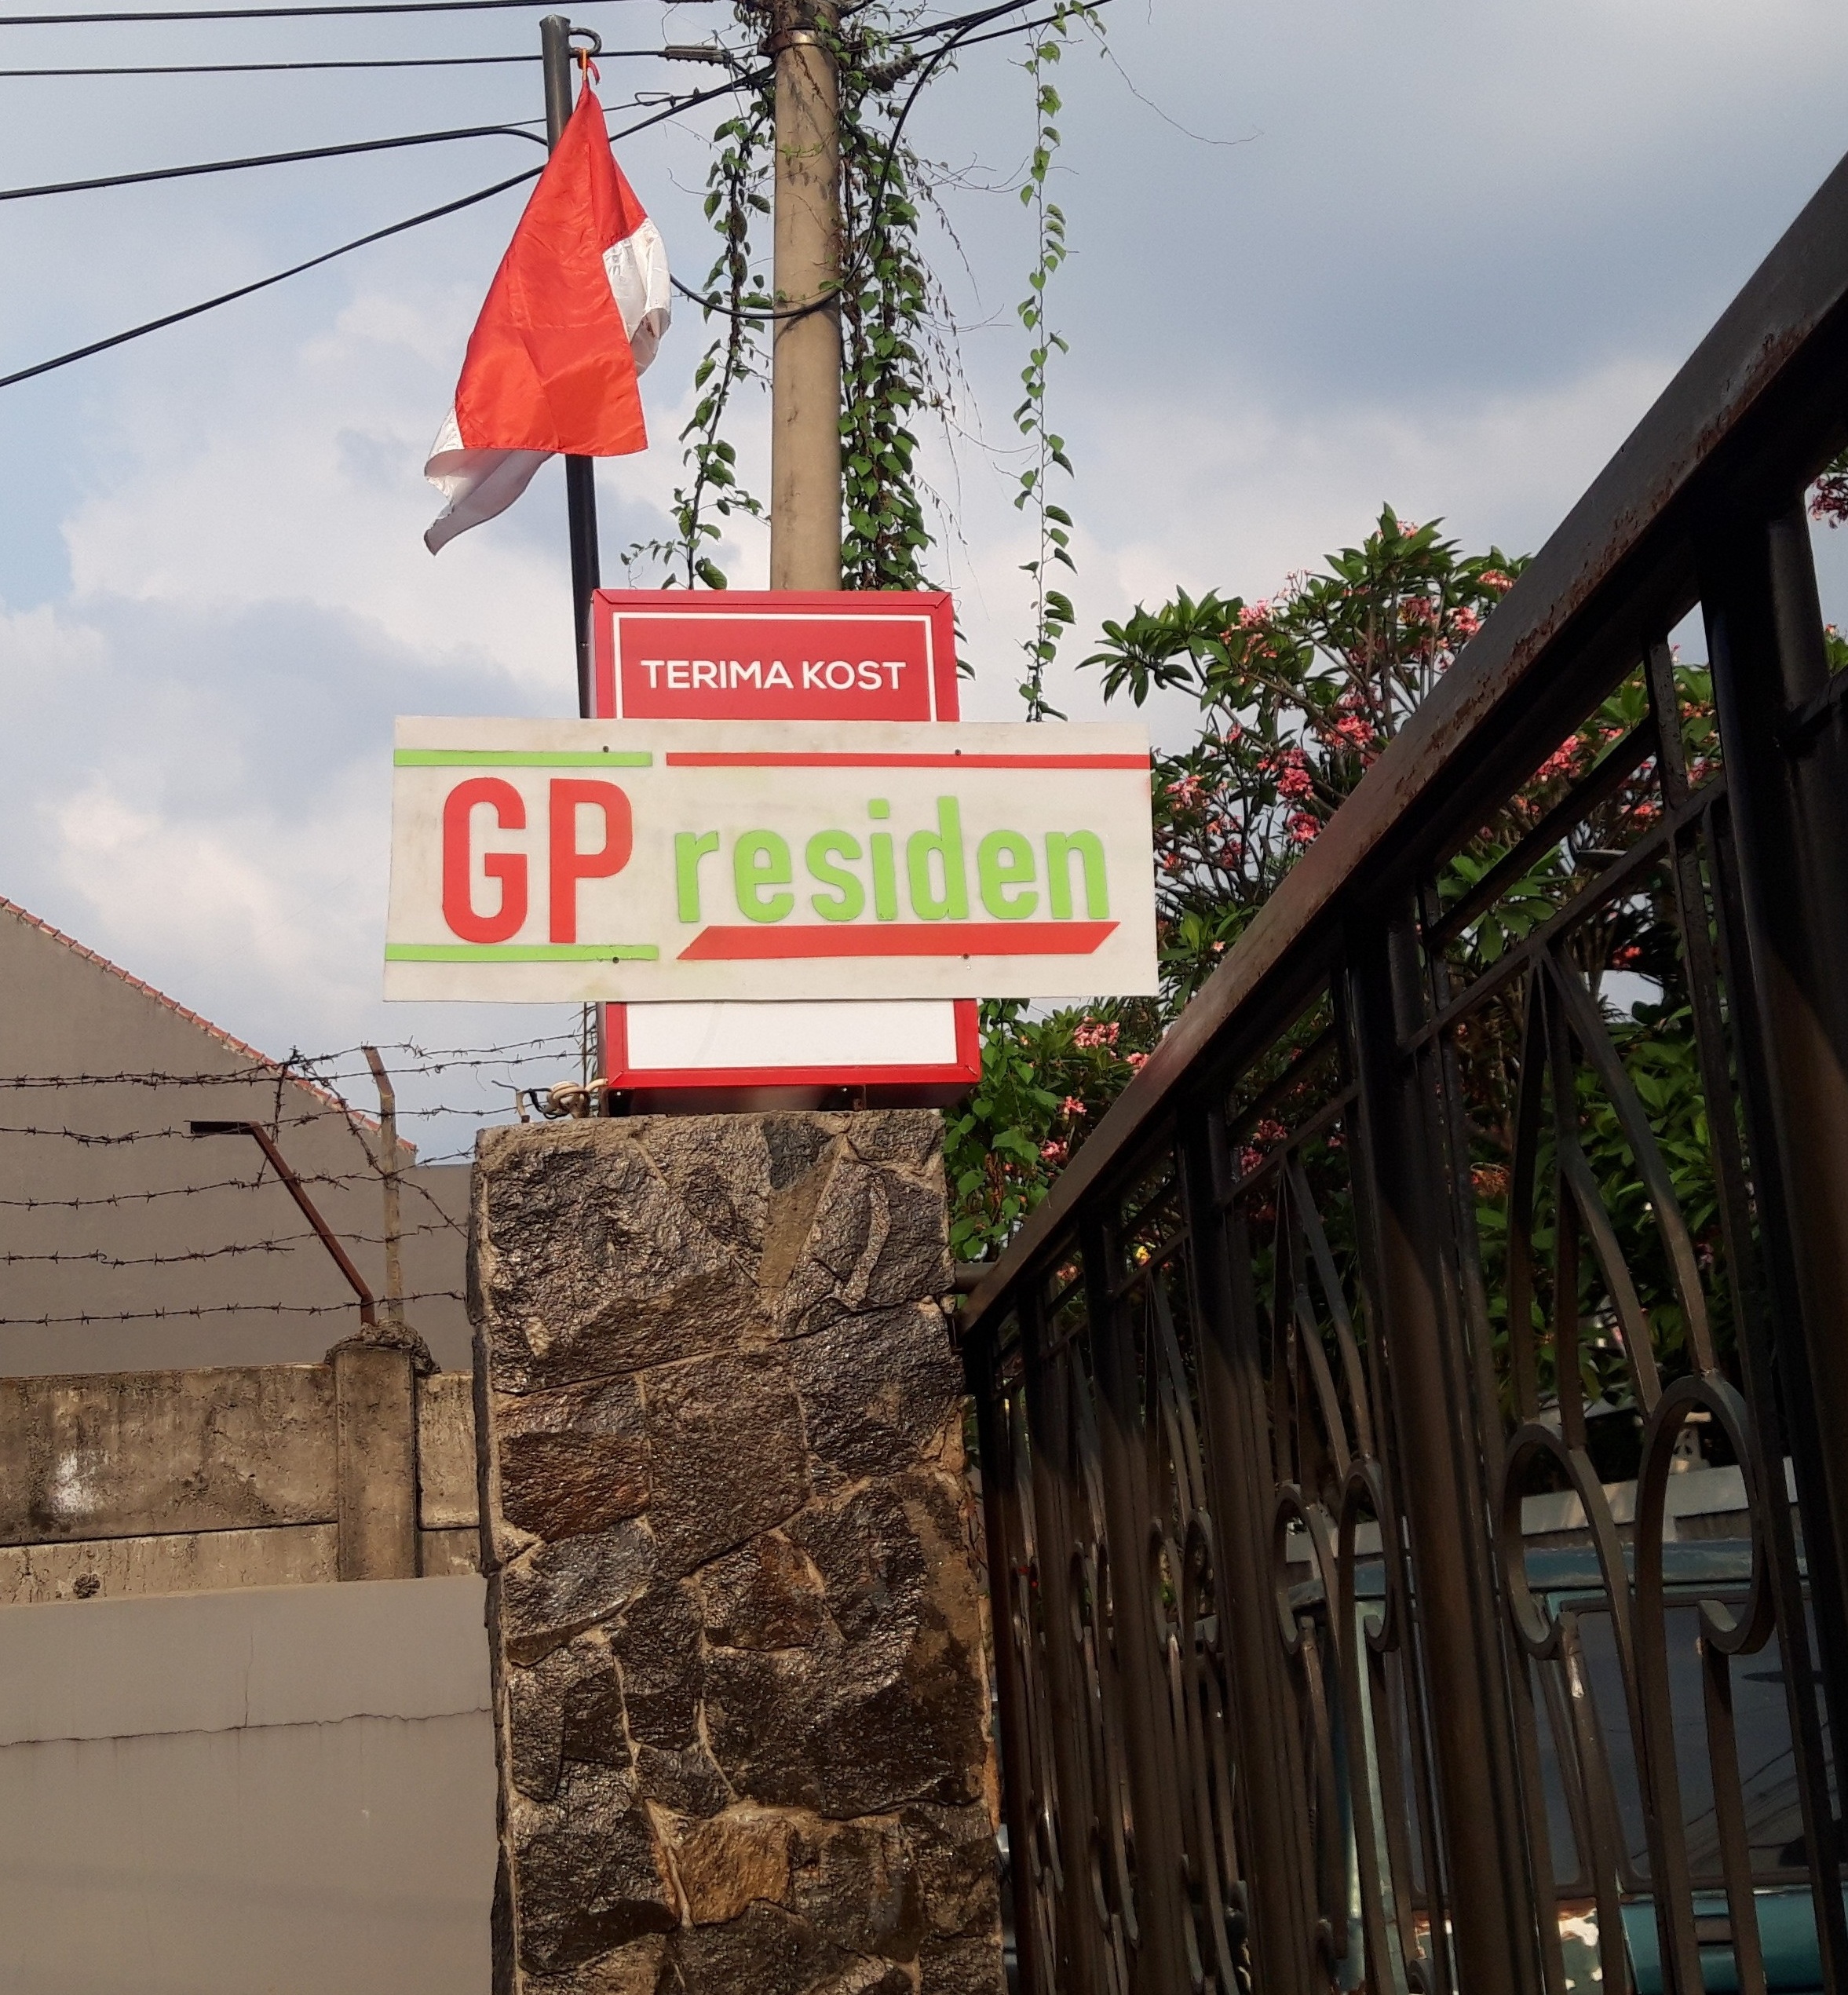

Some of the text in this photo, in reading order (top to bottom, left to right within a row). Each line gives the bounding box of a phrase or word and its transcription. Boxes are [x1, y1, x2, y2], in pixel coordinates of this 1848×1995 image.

[640, 660, 907, 690] TERIMA KOST
[441, 776, 1109, 945] GP residen
